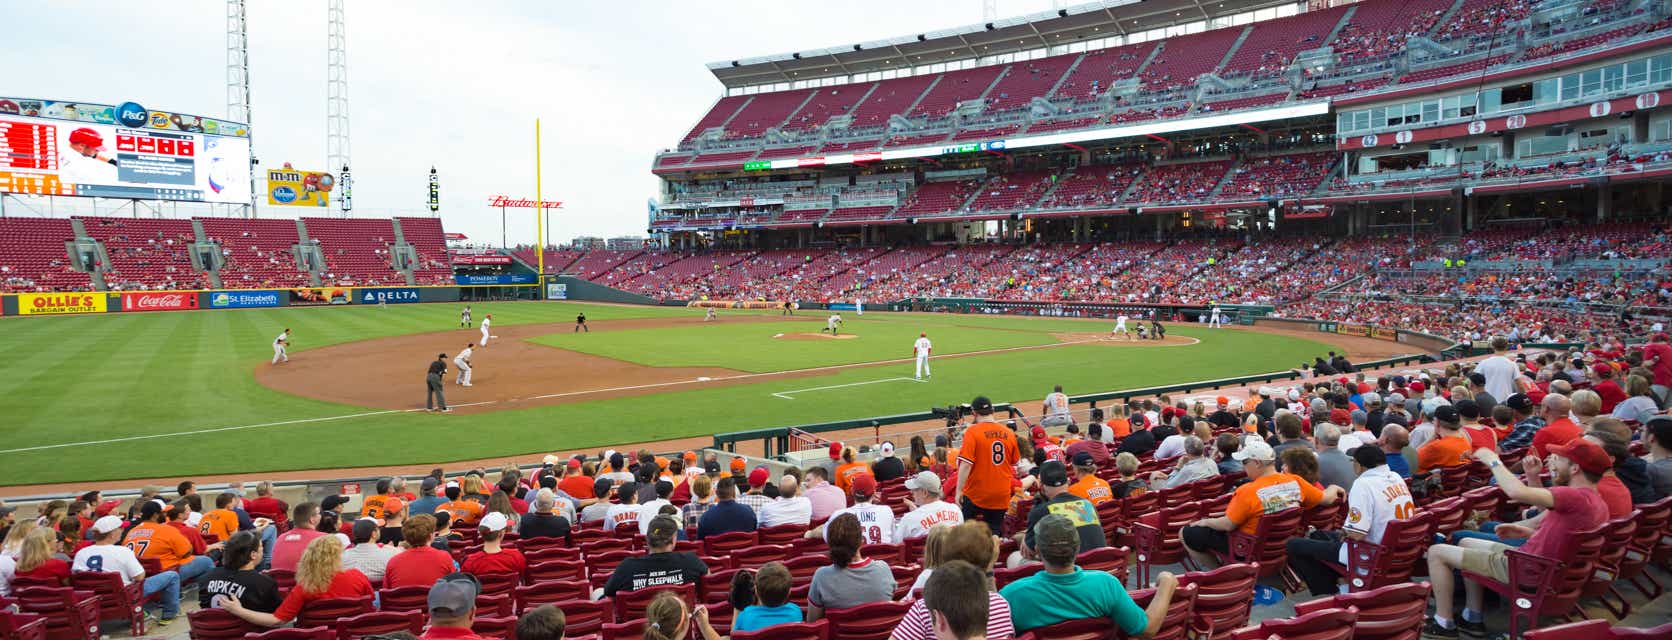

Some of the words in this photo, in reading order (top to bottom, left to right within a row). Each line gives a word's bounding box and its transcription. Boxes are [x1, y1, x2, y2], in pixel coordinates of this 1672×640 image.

[122, 110, 145, 120] P&G
[33, 294, 94, 308] OLLIE'S
[138, 294, 184, 308] Coca-Cola
[240, 295, 277, 303] Elizabeth
[377, 291, 418, 300] DELTA
[992, 440, 1005, 465] 8
[858, 511, 876, 522] ONG
[920, 510, 959, 529] PALMEIRO
[648, 574, 684, 586] SLEEPWALK
[207, 580, 246, 599] RIPKEN
